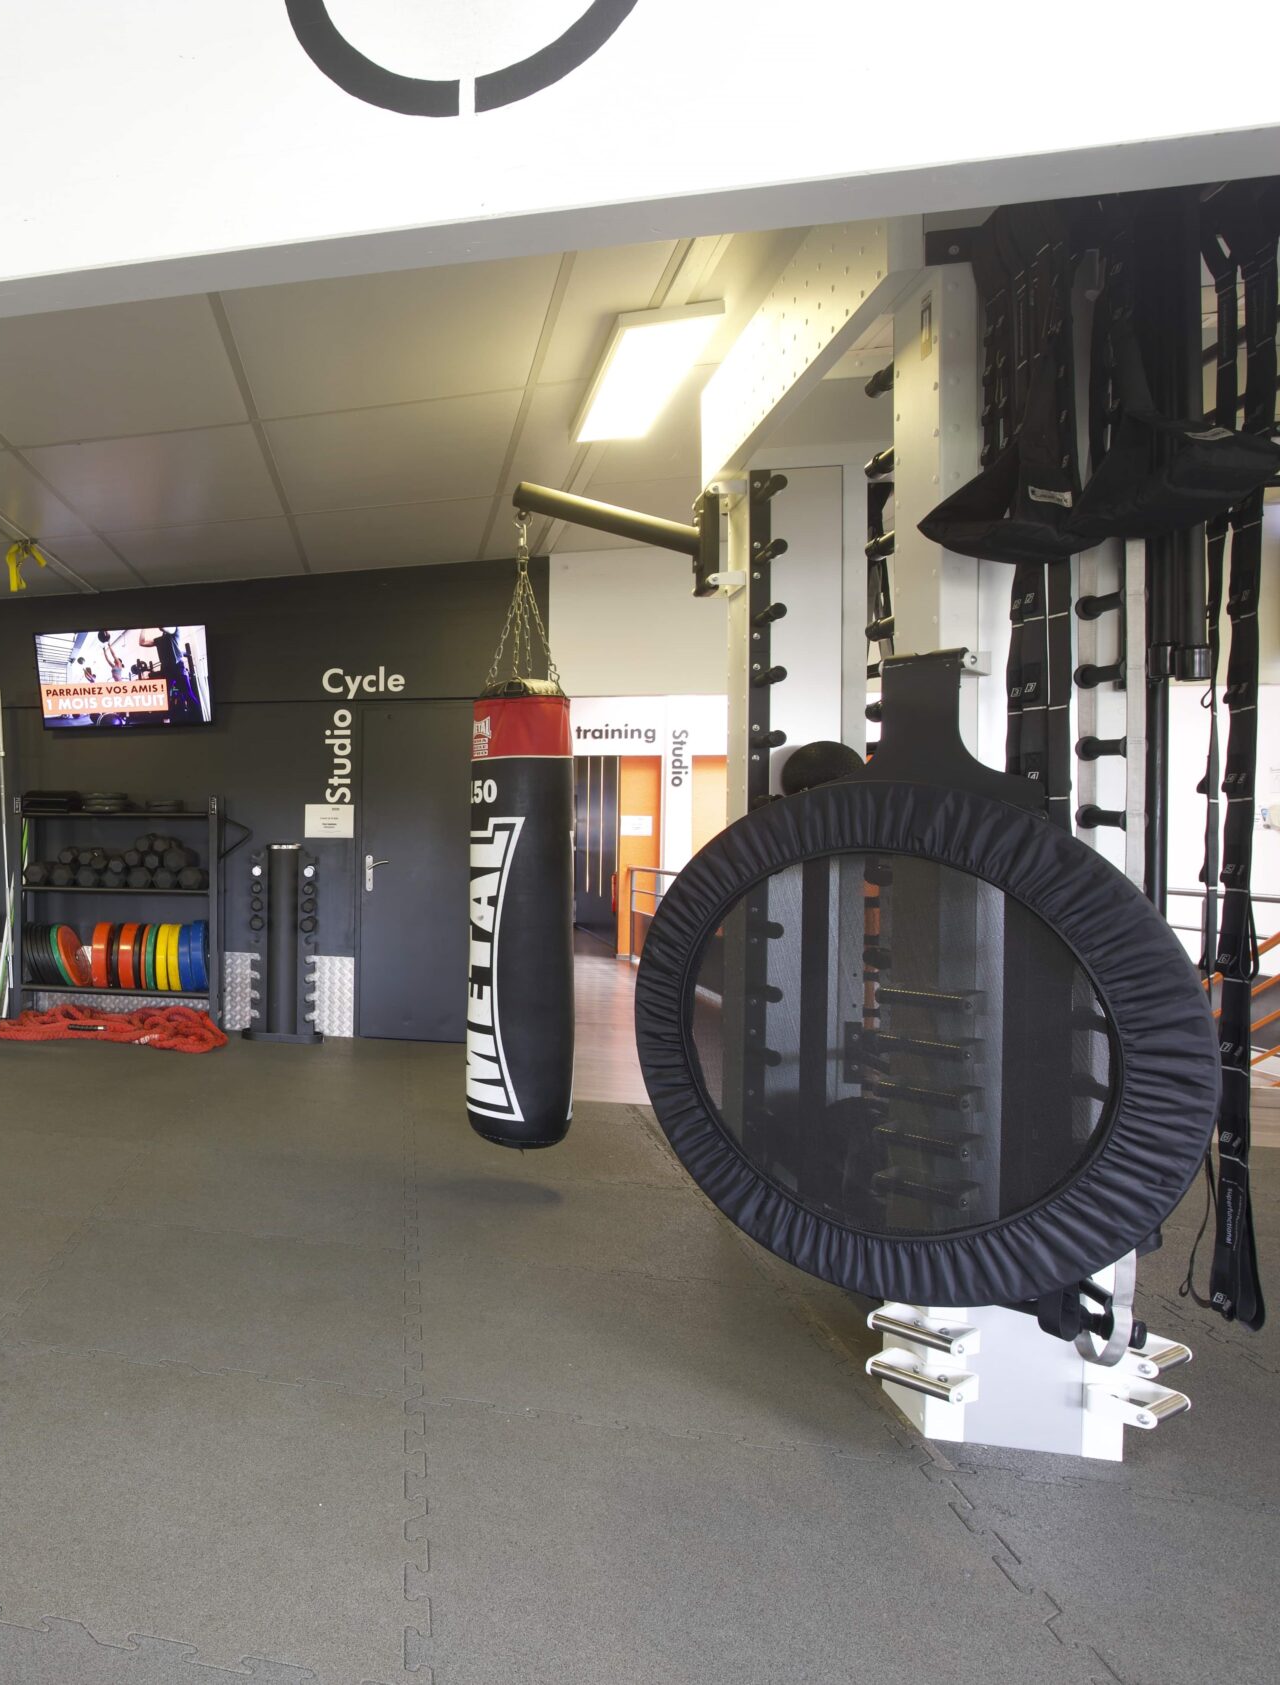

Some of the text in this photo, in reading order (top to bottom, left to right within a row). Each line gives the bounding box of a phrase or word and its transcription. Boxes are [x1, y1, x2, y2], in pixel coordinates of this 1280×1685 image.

[46, 686, 103, 697] PARRAINEZ
[106, 685, 128, 695] VOS
[131, 684, 158, 694] AMIS
[322, 665, 406, 700] Cycle
[46, 694, 165, 711] 1 MOIS GRATUIT
[575, 723, 657, 744] training
[325, 708, 353, 804] Studio
[671, 729, 689, 788] Studio
[471, 779, 498, 804] 50
